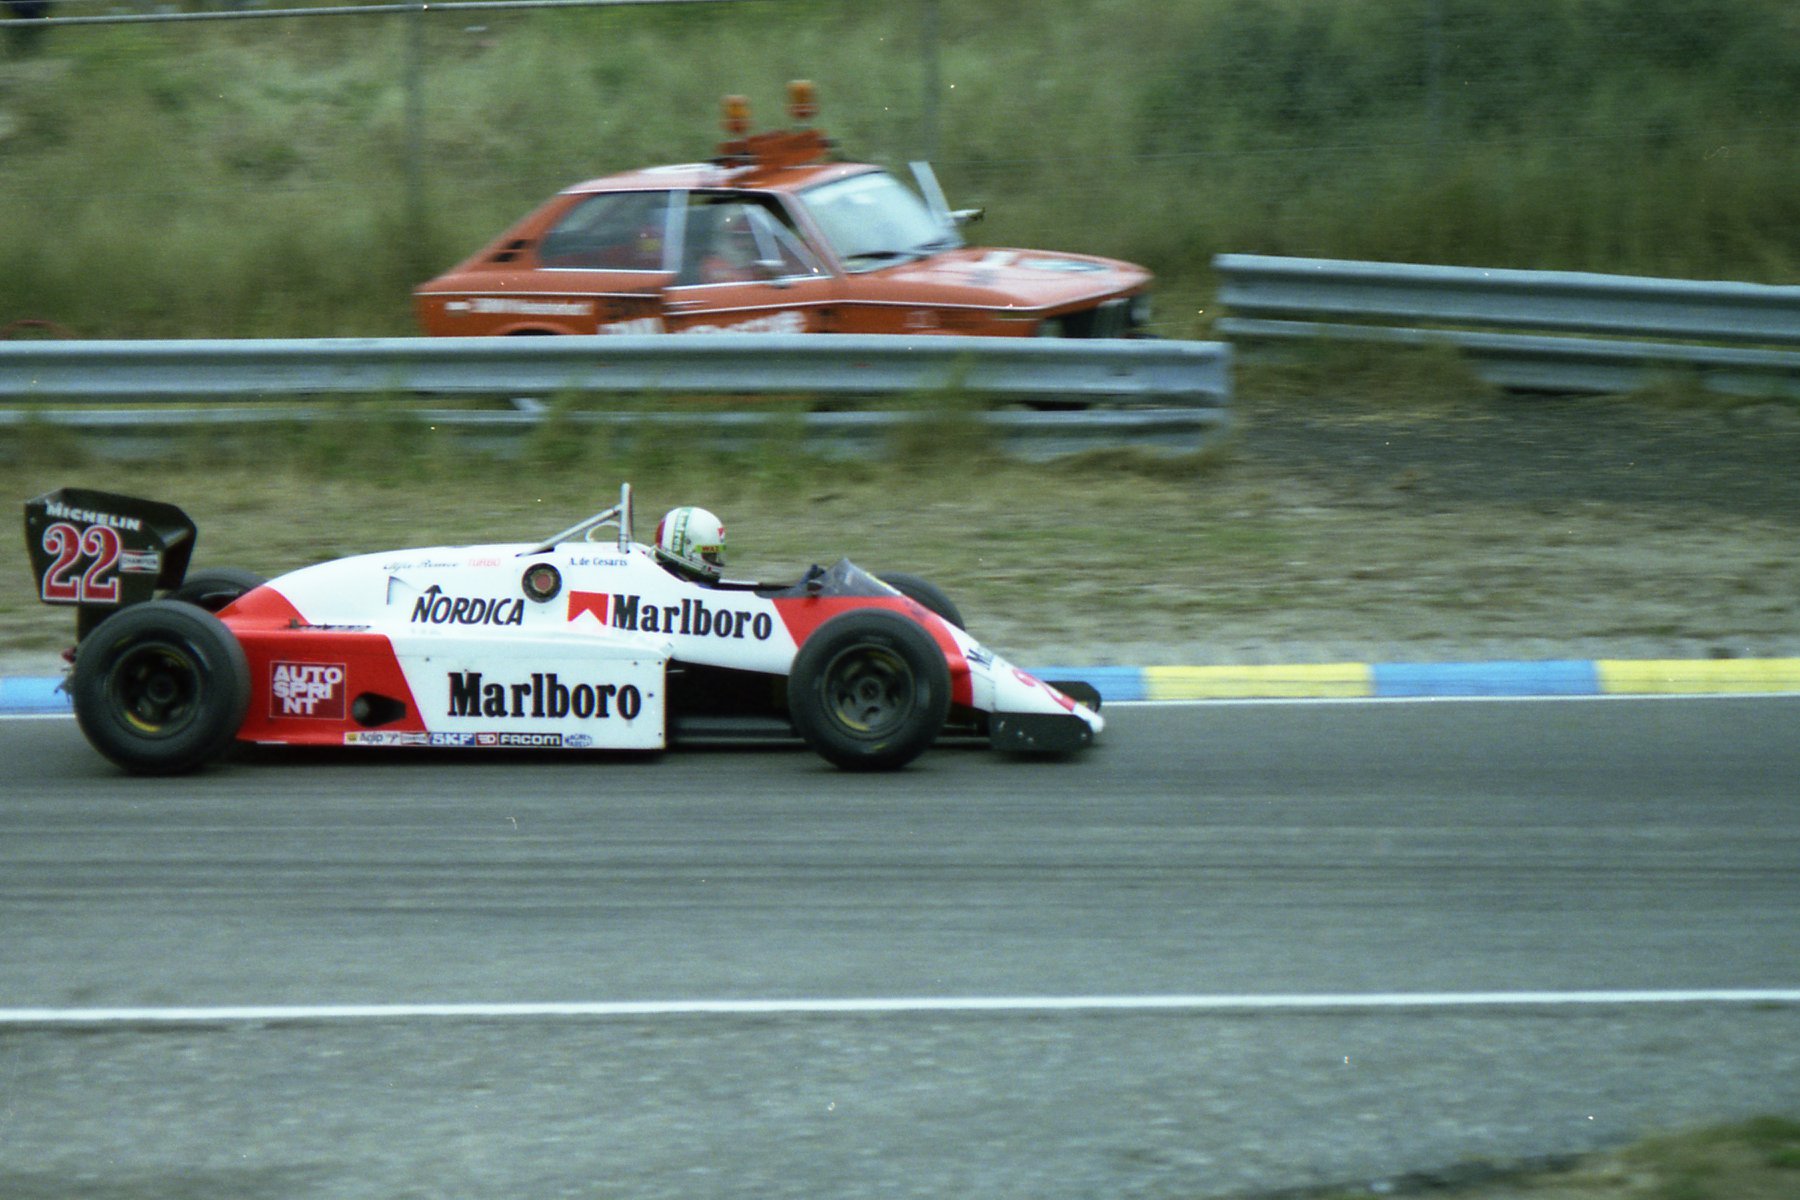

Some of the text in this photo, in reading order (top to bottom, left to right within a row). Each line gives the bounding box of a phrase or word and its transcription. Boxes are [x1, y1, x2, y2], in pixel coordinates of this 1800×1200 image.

[45, 499, 141, 531] MICHELIN
[43, 522, 119, 602] 22
[411, 585, 524, 625] NORDICA
[612, 594, 772, 640] Marlboro
[272, 681, 332, 699] SPRI
[273, 665, 343, 684] AUTO
[283, 697, 318, 715] NT
[448, 672, 641, 720] Marlboro
[432, 733, 473, 745] SKF
